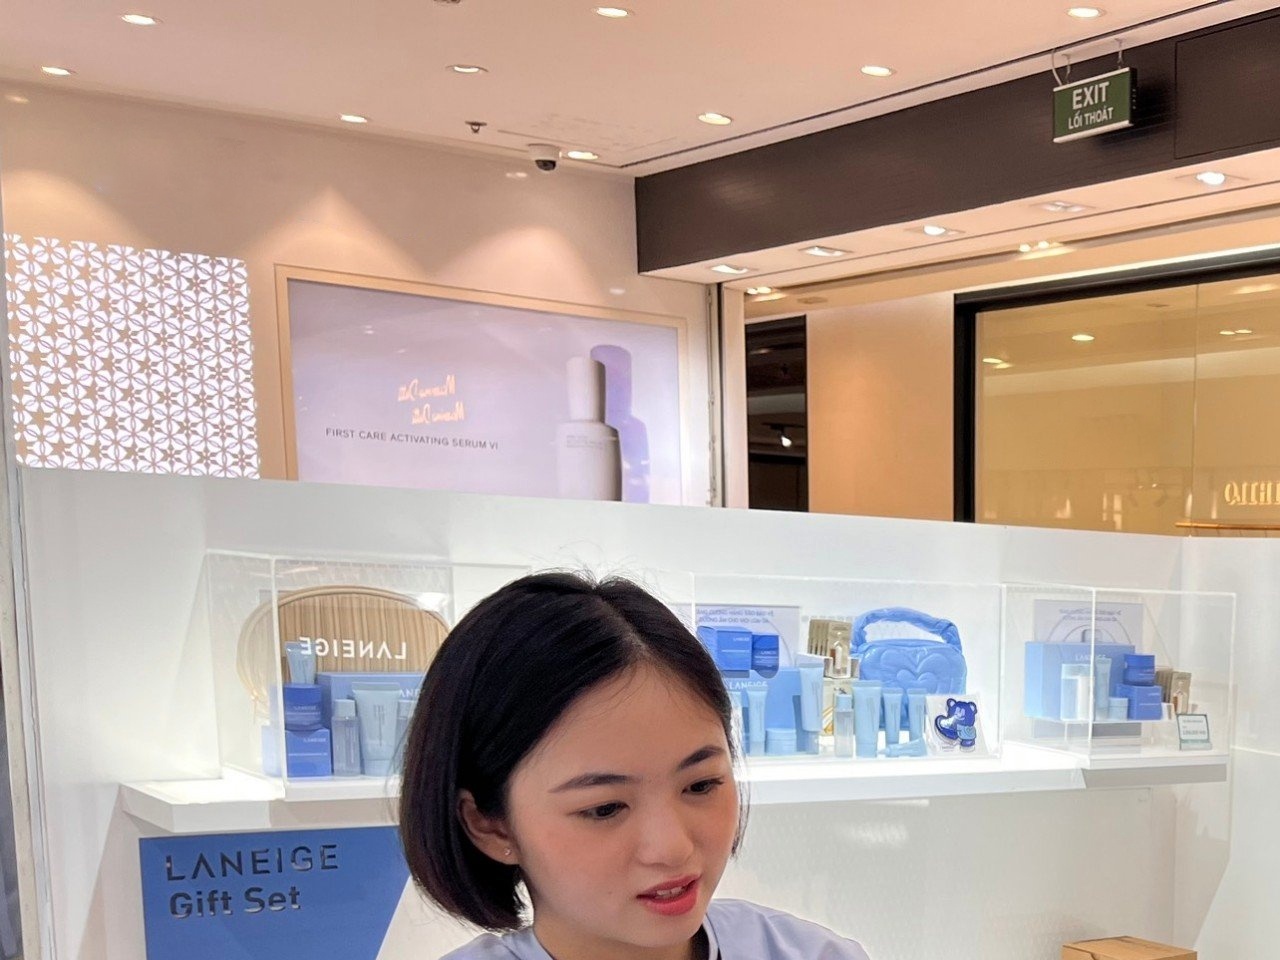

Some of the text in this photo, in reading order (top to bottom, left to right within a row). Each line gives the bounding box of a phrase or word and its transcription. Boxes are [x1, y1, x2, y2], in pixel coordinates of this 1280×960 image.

[1072, 81, 1110, 110] EXIT
[1068, 107, 1114, 130] LỐI THOÁT
[325, 427, 499, 450] FIRST CARE ACTIVATING SERUM VI
[166, 843, 339, 882] LANEIGE
[169, 885, 301, 919] Gift Set
